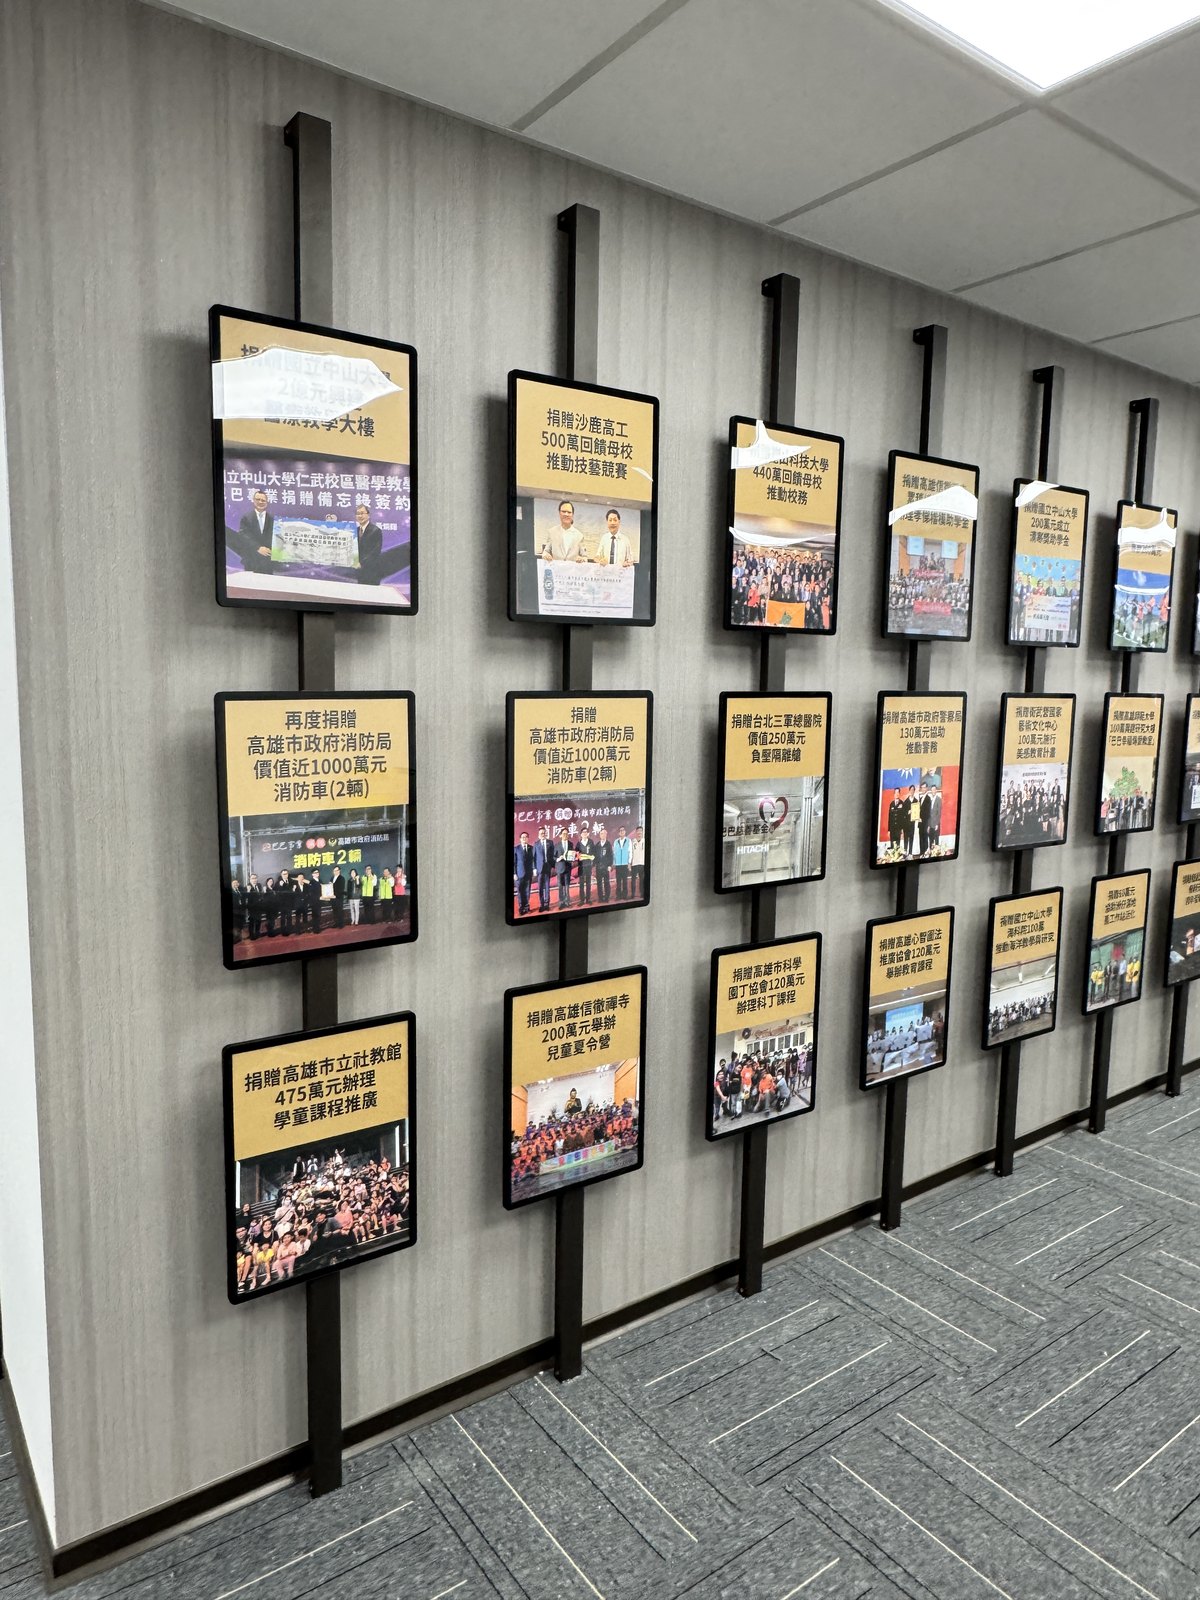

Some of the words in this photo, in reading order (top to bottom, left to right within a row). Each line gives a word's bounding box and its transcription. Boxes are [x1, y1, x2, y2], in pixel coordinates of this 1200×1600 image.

[546, 408, 628, 438] 捐贈沙鹿高工
[541, 430, 634, 460] 500萬回饋母校
[546, 451, 628, 480] 推動技藝競賽
[770, 454, 829, 473] 山科技大學
[224, 469, 411, 492] 立中山大學仁武校區醫學教
[753, 466, 822, 490] 440萬回饋母校
[766, 484, 808, 505] 推動校務
[285, 709, 357, 730] 再度捐贈
[570, 706, 597, 724] 捐贈
[731, 713, 822, 728] 捐贈台北三軍總醫院
[247, 732, 392, 756] 高雄市政府消防局
[529, 726, 635, 745] 高雄市政府消防局
[748, 731, 806, 746] 價值250萬元
[900, 725, 945, 739] 130萬元協助
[533, 745, 631, 766] 價值近1000萬元
[751, 747, 801, 763] 負壓隔離艙
[253, 755, 387, 780] 價值近1000萬元
[547, 765, 617, 784] 消防車(2輛)
[274, 777, 370, 802] 消防車(2輛)
[573, 805, 631, 818] 高雄市政府消防局
[736, 843, 769, 854] HITACHI
[732, 956, 802, 984] 捐贈高雄市科學
[728, 972, 805, 1001] 園丁協會120萬元
[526, 993, 630, 1028] 捐贈高雄信徹禪寺
[736, 989, 796, 1015] 辦理科丁課程
[541, 1014, 617, 1043] 200萬元舉辦
[546, 1034, 611, 1062] 兒童夏令營
[244, 1043, 402, 1092] 捐贈高雄市立社教館
[274, 1069, 376, 1106] 475萬元辦理
[273, 1090, 378, 1130] 學童課程推廣
